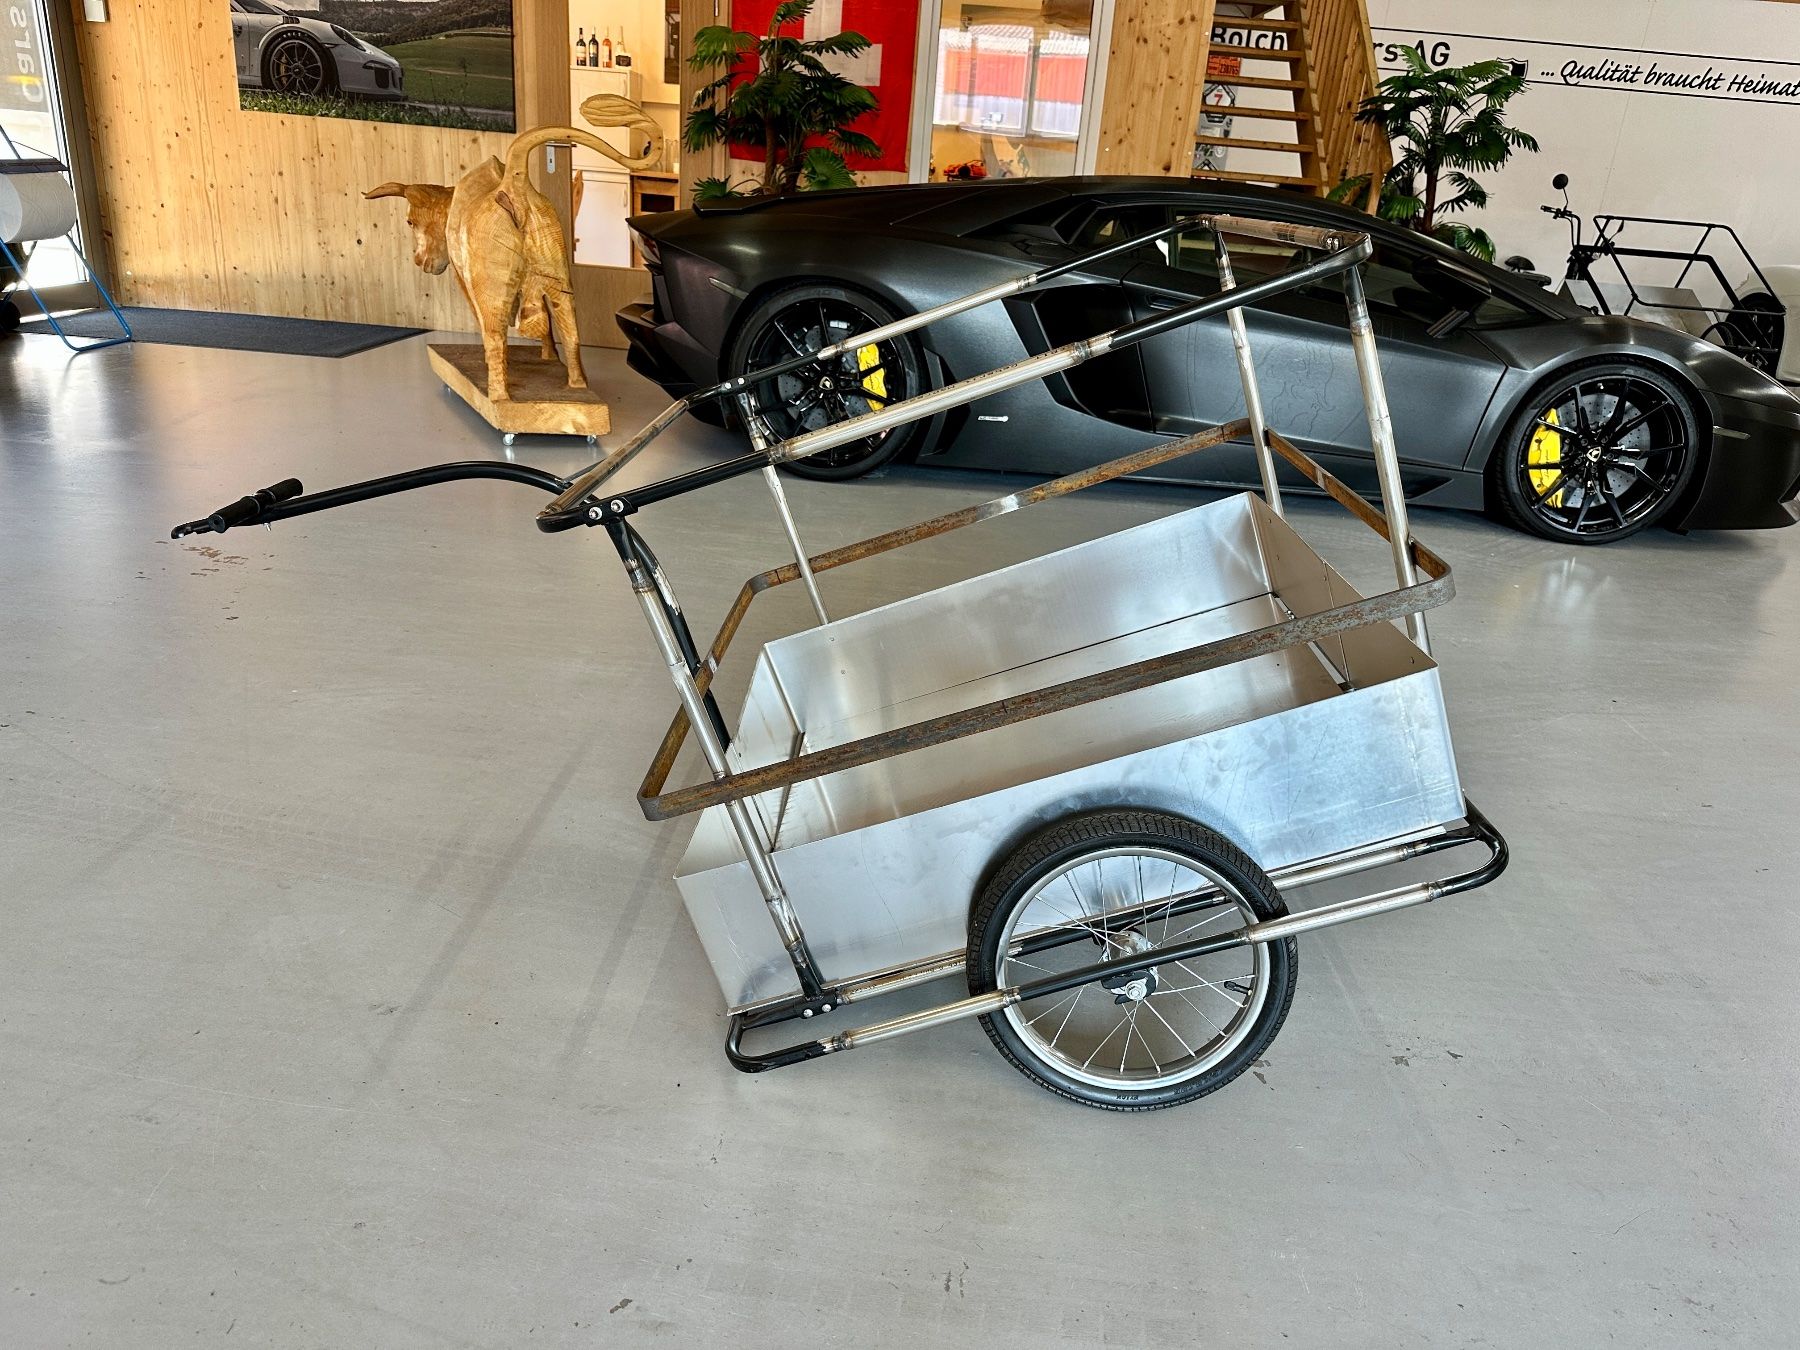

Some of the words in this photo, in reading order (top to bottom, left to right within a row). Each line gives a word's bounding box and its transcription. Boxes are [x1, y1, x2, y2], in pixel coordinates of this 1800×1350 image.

[1412, 39, 1451, 67] AG
[1560, 58, 1645, 86] Qualität
[1643, 62, 1726, 91] braucht
[1726, 73, 1800, 97] Heimat
